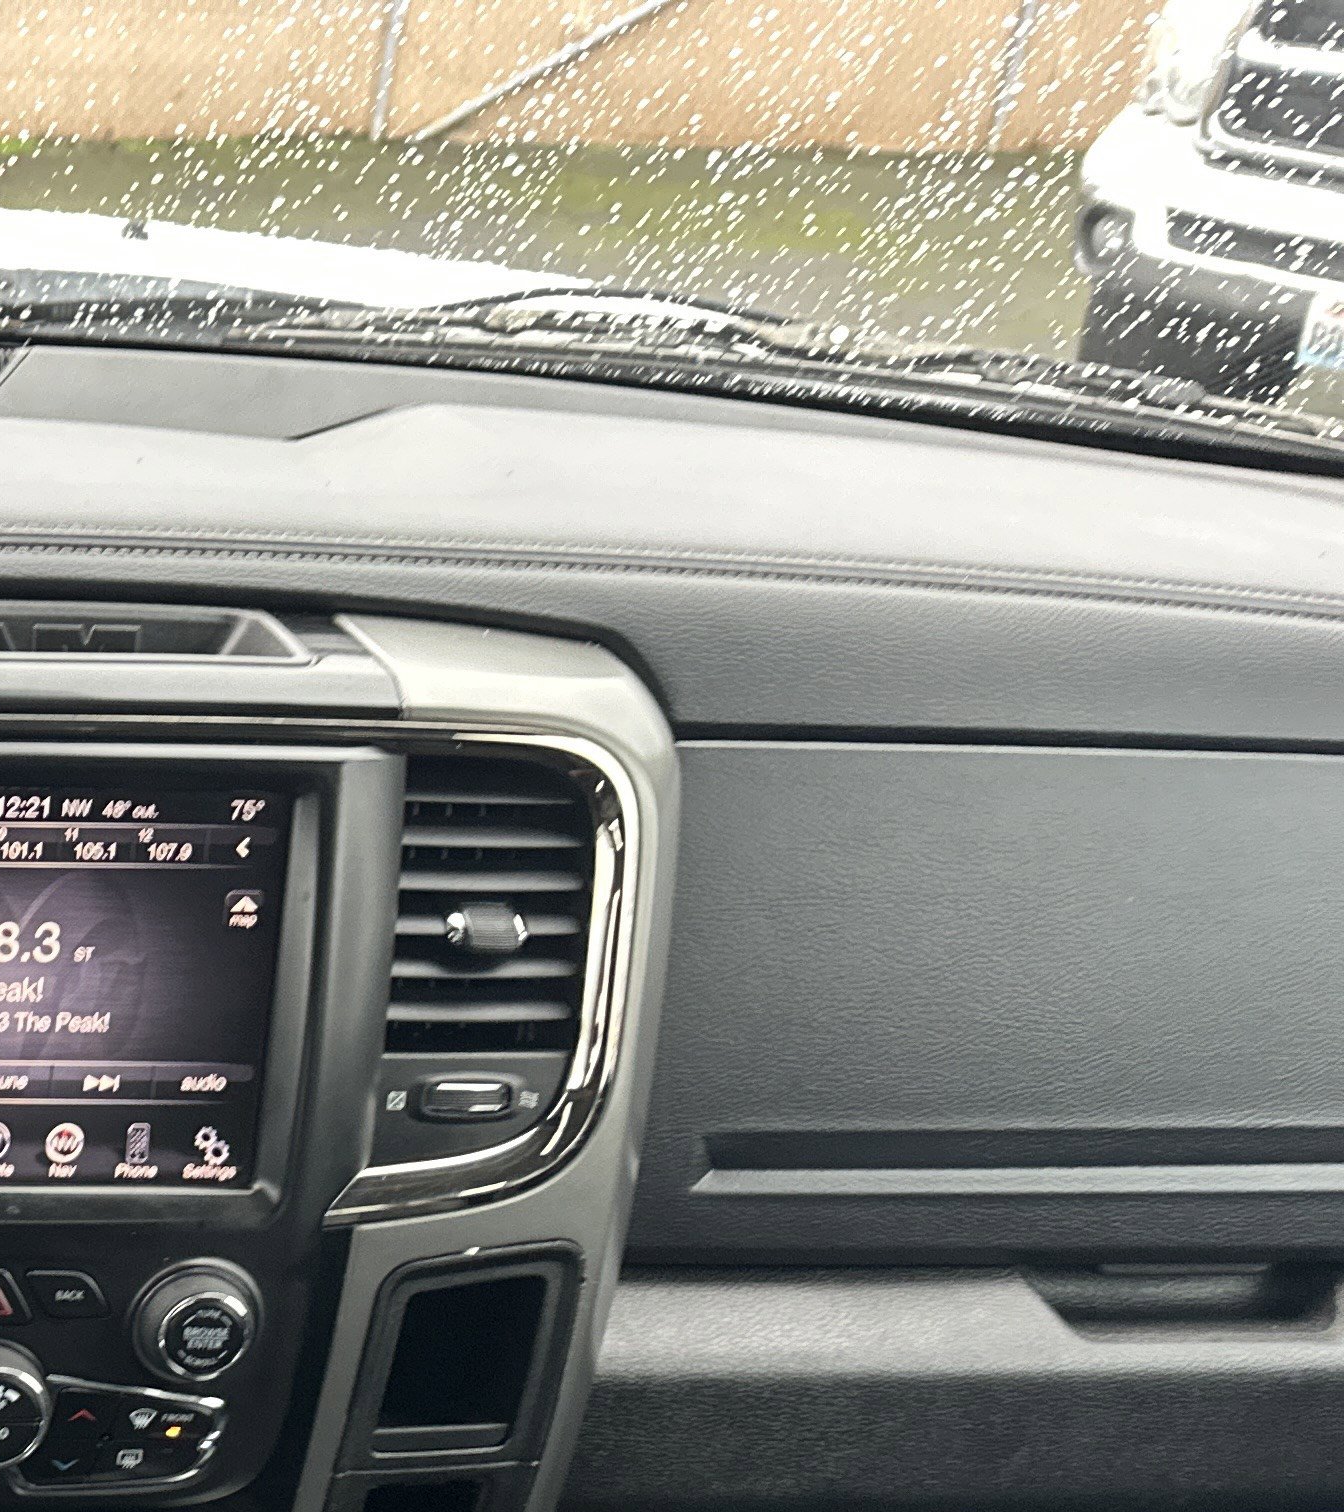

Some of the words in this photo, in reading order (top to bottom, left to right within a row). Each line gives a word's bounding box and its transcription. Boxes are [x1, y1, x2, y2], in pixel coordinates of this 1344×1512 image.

[137, 827, 155, 843] 12
[0, 841, 44, 861] 101.1
[73, 841, 118, 861] 105.1
[147, 842, 193, 862] 107.9
[12, 1010, 52, 1034] The
[54, 1011, 112, 1034] Peak!
[179, 1073, 228, 1093] audio
[47, 1162, 78, 1179] Nav
[113, 1161, 159, 1180] Phone
[181, 1162, 238, 1182] Settings
